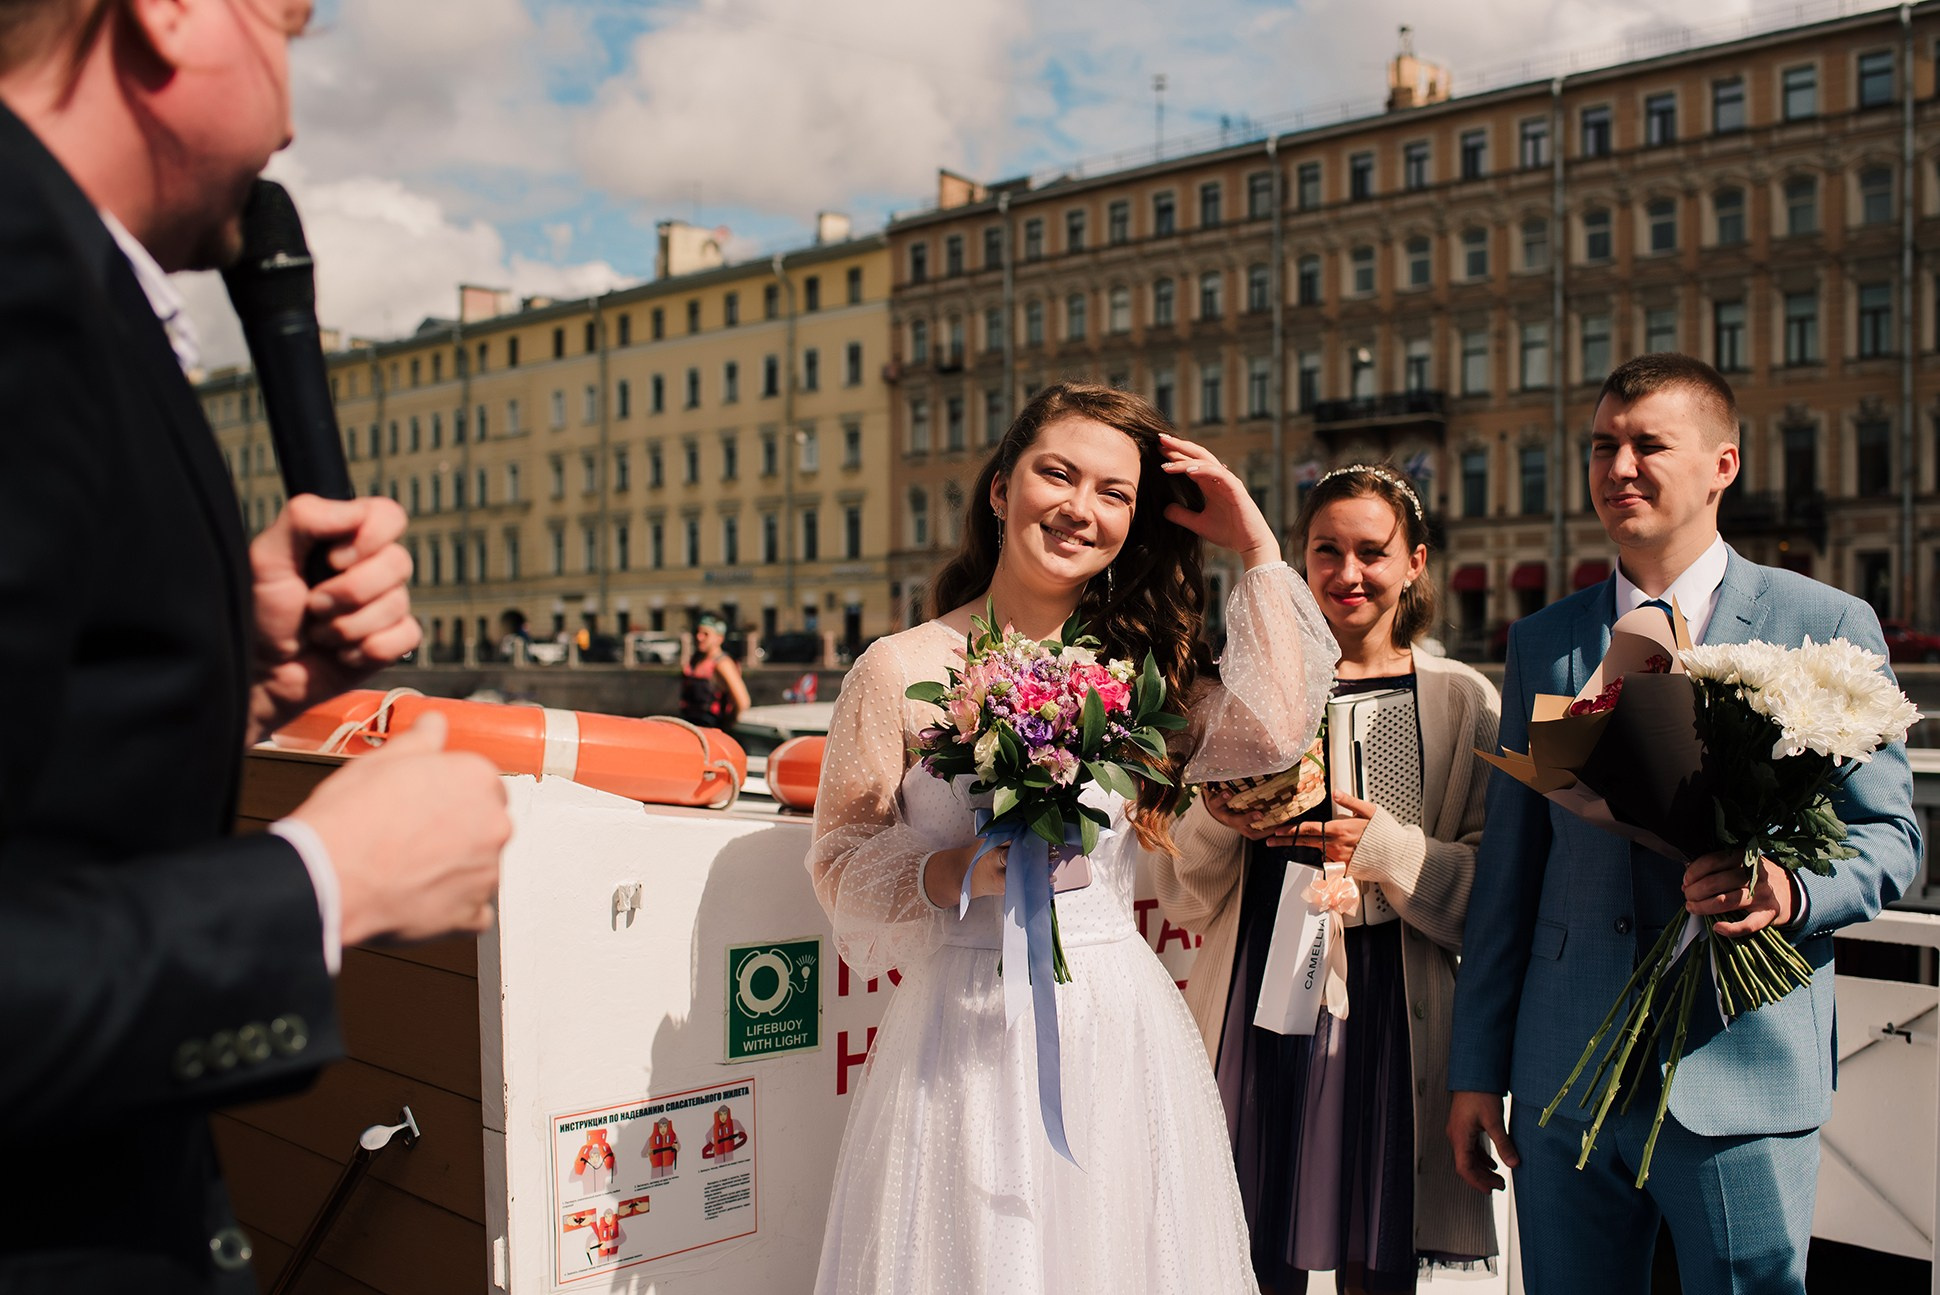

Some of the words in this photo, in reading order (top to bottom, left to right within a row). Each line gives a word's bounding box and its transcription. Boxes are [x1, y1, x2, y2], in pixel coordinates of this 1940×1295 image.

[1305, 918, 1326, 990] CAMELLIA
[743, 1038, 772, 1052] WITH
[775, 1033, 808, 1048] LIGHT
[747, 1019, 803, 1037] LIFEBUOY
[559, 1115, 608, 1133] ИНСТРУКЦИЯ
[610, 1113, 619, 1124] ПО
[620, 1104, 664, 1121] НАДЕВАНИЮ
[665, 1093, 722, 1112] СПАСАТЕЛЬНОГО
[722, 1086, 750, 1100] ЖИЛЕТА
